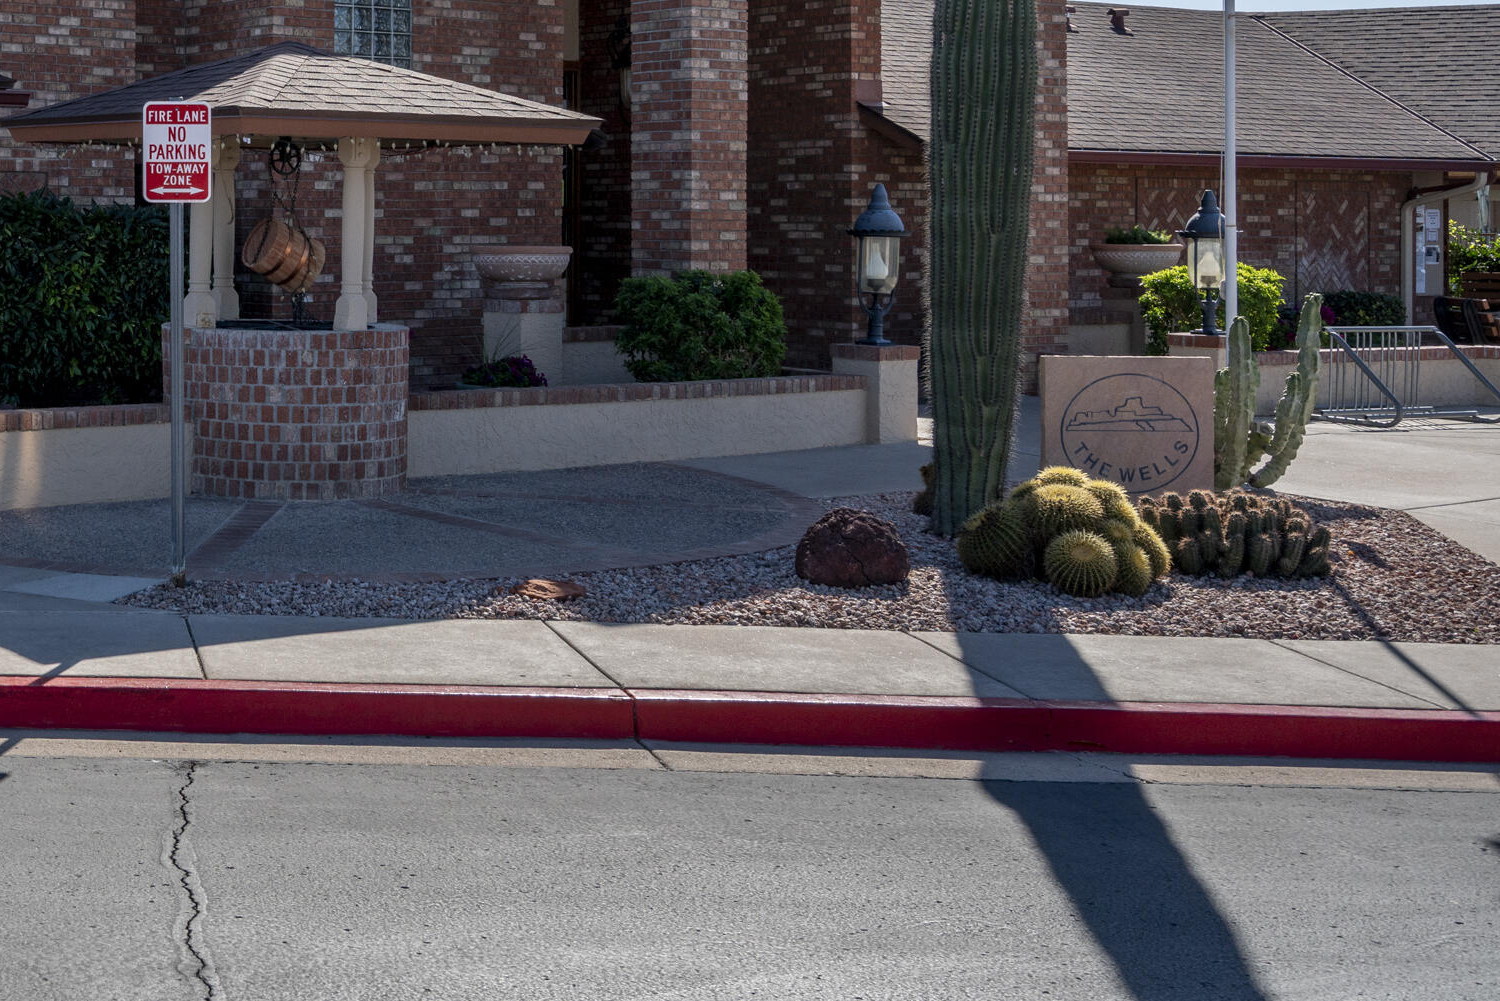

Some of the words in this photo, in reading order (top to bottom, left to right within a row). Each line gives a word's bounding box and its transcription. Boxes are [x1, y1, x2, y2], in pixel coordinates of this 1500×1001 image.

[148, 110, 173, 122] FIRE
[177, 110, 207, 122] LANE
[168, 126, 186, 142] NO
[149, 144, 206, 160] PARKING
[149, 163, 206, 174] TOW-AWAY
[163, 175, 192, 186] ZONE
[1074, 441, 1112, 478] THE
[1120, 440, 1189, 483] WELLS
